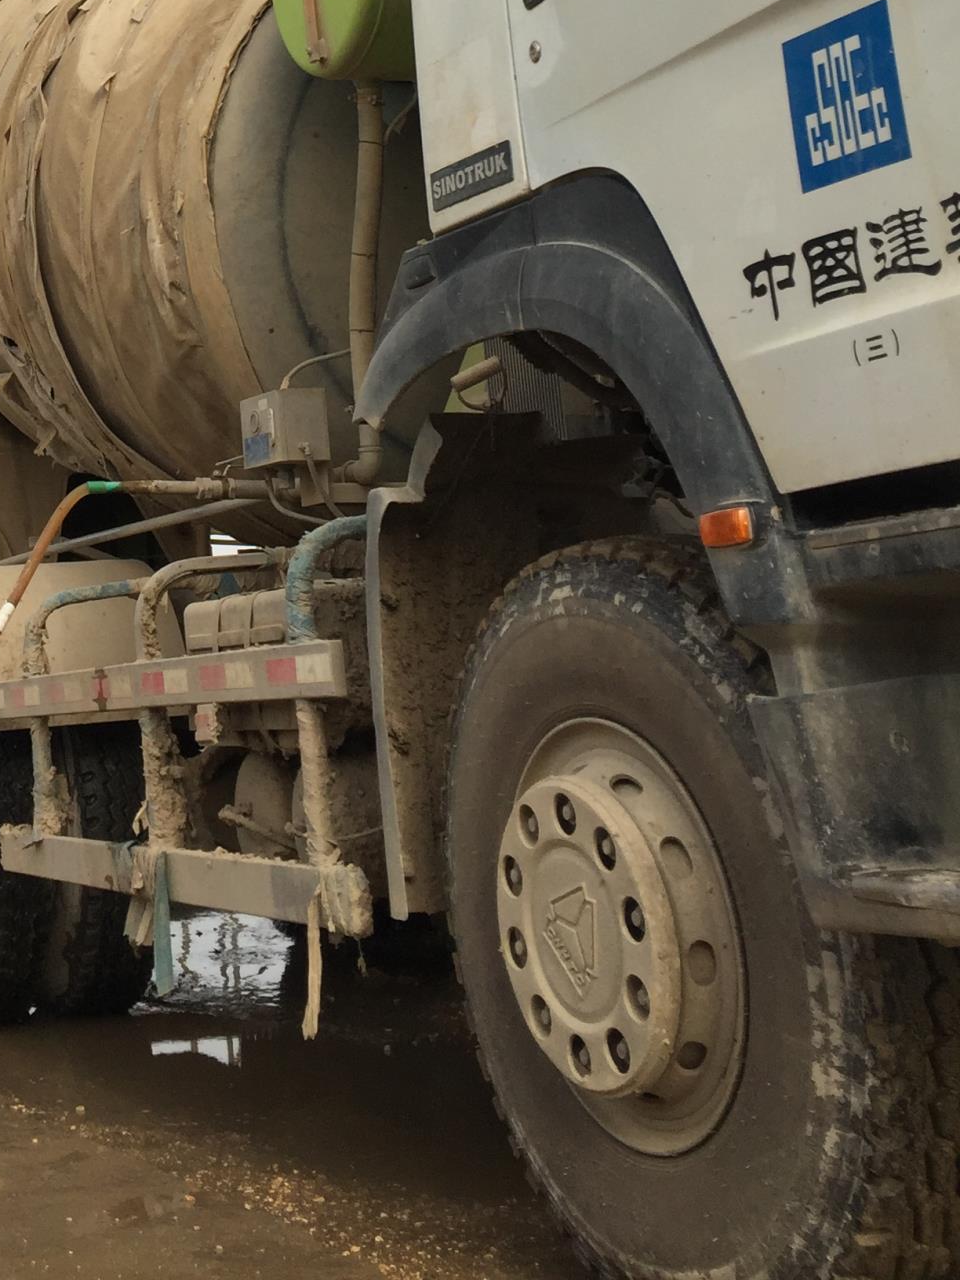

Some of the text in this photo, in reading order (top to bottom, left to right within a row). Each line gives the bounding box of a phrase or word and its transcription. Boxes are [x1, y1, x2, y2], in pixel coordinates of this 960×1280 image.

[432, 151, 508, 199] SINOTRUK
[742, 191, 960, 321] 中國建
